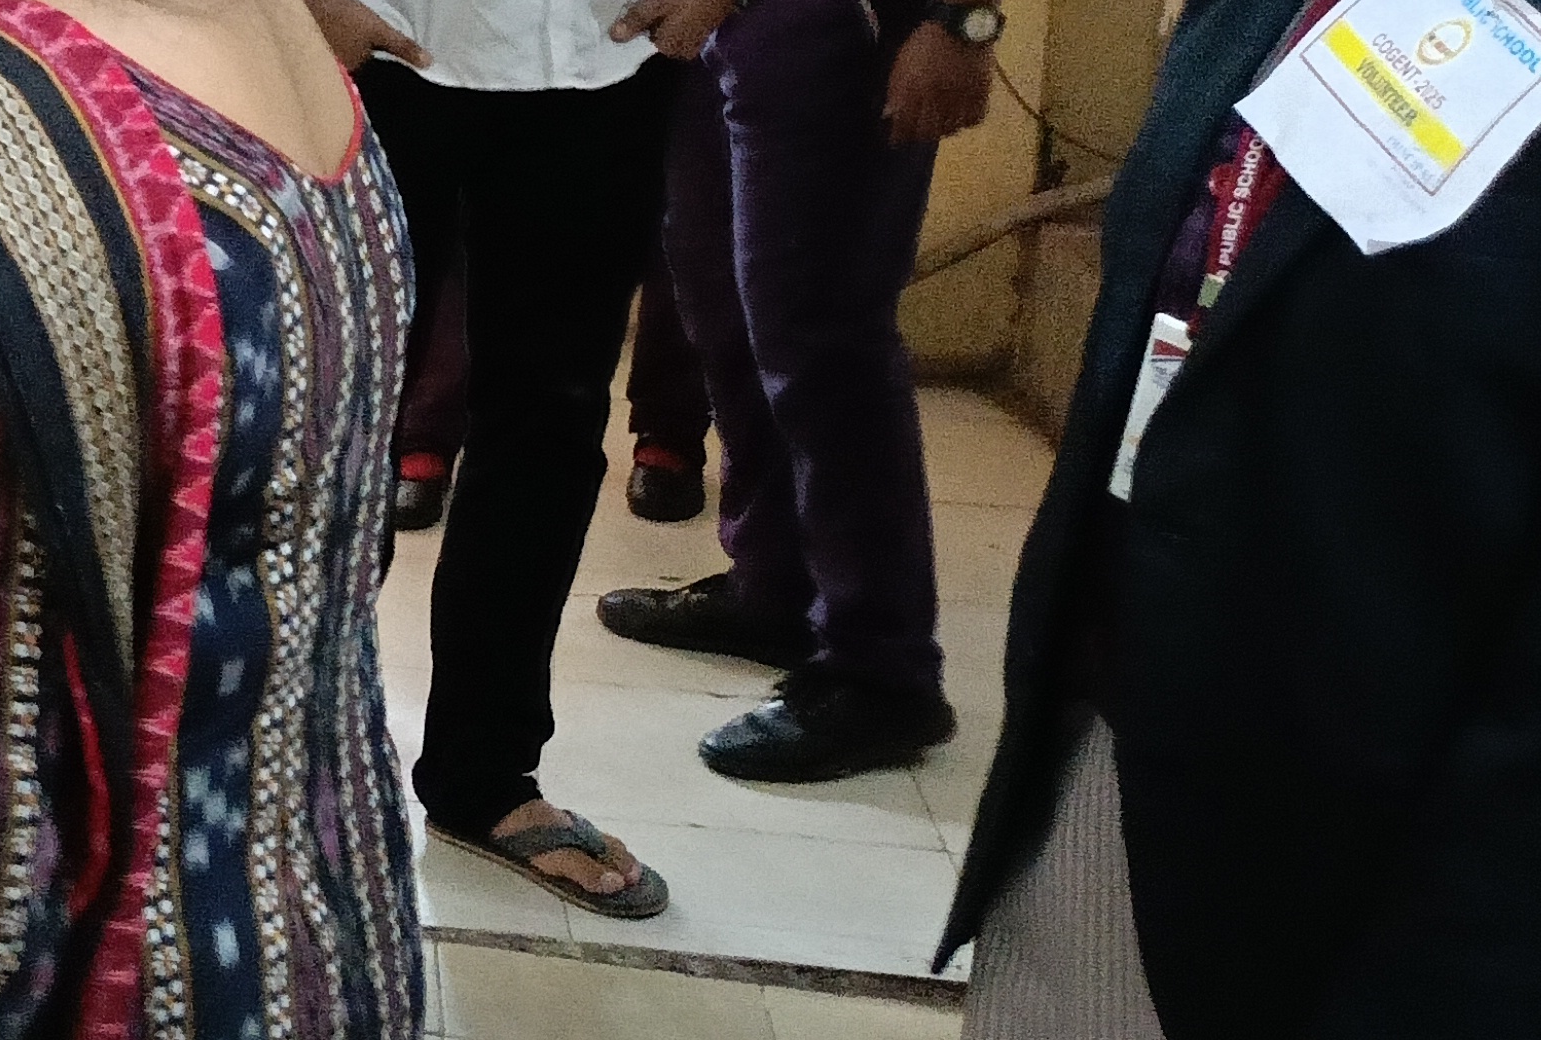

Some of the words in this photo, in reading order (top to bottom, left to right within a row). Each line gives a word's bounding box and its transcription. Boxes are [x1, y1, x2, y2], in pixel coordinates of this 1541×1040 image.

[1487, 16, 1541, 74] CHOOL
[1356, 57, 1419, 128] VOLUNTEER
[1218, 199, 1246, 266] PUBLIC
[1232, 137, 1265, 198] SCHOO
